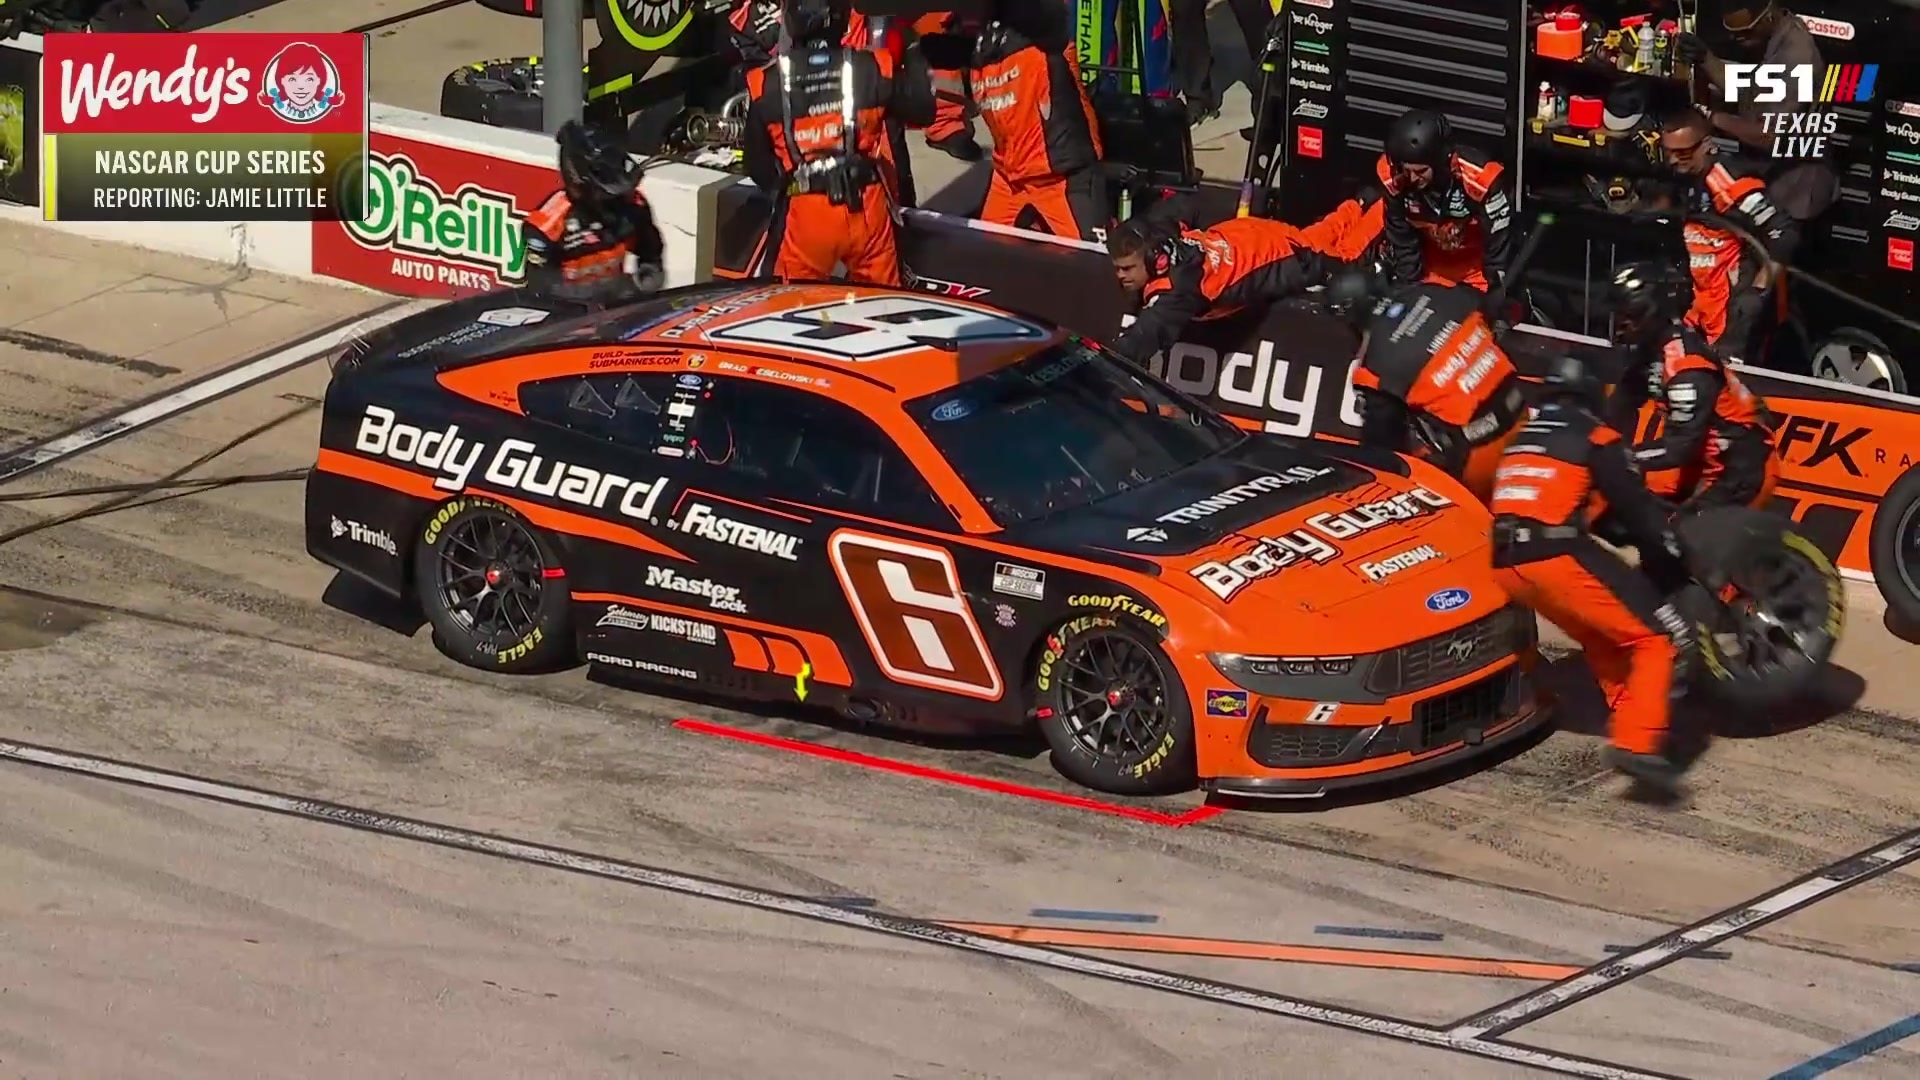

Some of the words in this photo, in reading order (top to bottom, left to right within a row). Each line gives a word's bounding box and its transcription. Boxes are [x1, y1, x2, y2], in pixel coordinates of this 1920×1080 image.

[1304, 12, 1334, 34] Kroger
[1806, 19, 1850, 37] Castrol
[1300, 60, 1330, 74] Trimble
[354, 164, 527, 273] O'Reilly
[391, 258, 434, 282] AUTO
[438, 265, 492, 292] PARTS
[589, 356, 681, 369] SUBMARINES.COM
[592, 350, 624, 359] BUILD
[718, 361, 748, 373] BRAD
[1149, 340, 1323, 438] ody
[1770, 411, 1875, 479] FK
[355, 405, 486, 491] Body
[484, 438, 670, 521] Guard
[1155, 465, 1335, 526] TRINITYRAIL
[346, 520, 398, 556] Trimble
[681, 503, 801, 561] FASTENAL
[1191, 529, 1338, 601] Body
[1305, 482, 1452, 539] Guard
[645, 565, 741, 602] Master
[709, 597, 748, 614] Lock
[826, 526, 1006, 702] 6
[1067, 594, 1167, 628] GOODYEAR
[1431, 591, 1468, 611] Ford
[650, 613, 717, 640] KICKSTAND
[498, 626, 544, 664] EAGLE
[587, 652, 633, 668] FORD
[635, 661, 698, 680] RACING
[1305, 702, 1340, 724] 6
[1133, 731, 1176, 779] EAGLE
